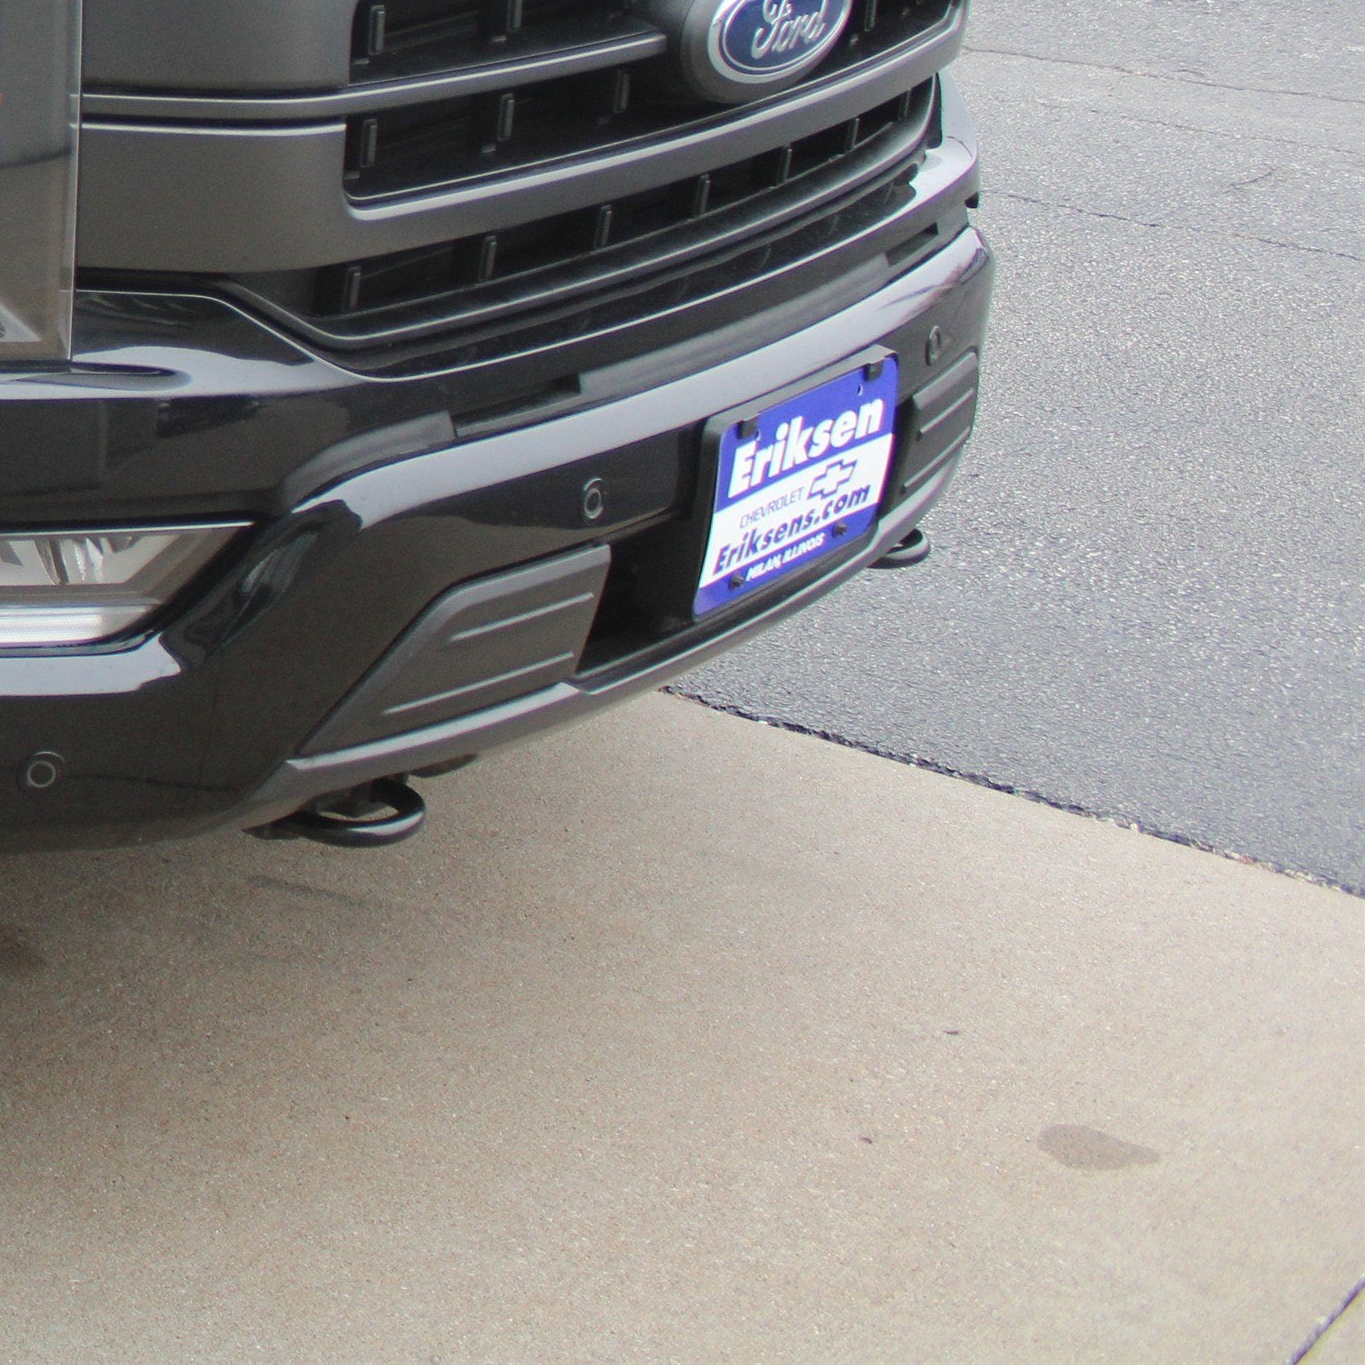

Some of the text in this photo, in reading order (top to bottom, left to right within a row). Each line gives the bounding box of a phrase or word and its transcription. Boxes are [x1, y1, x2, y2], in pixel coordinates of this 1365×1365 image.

[727, 398, 884, 499] Eriksen
[712, 484, 871, 576] Eriksens.com
[739, 486, 805, 529] CHEVROLET
[782, 532, 826, 565] ILLINOIS
